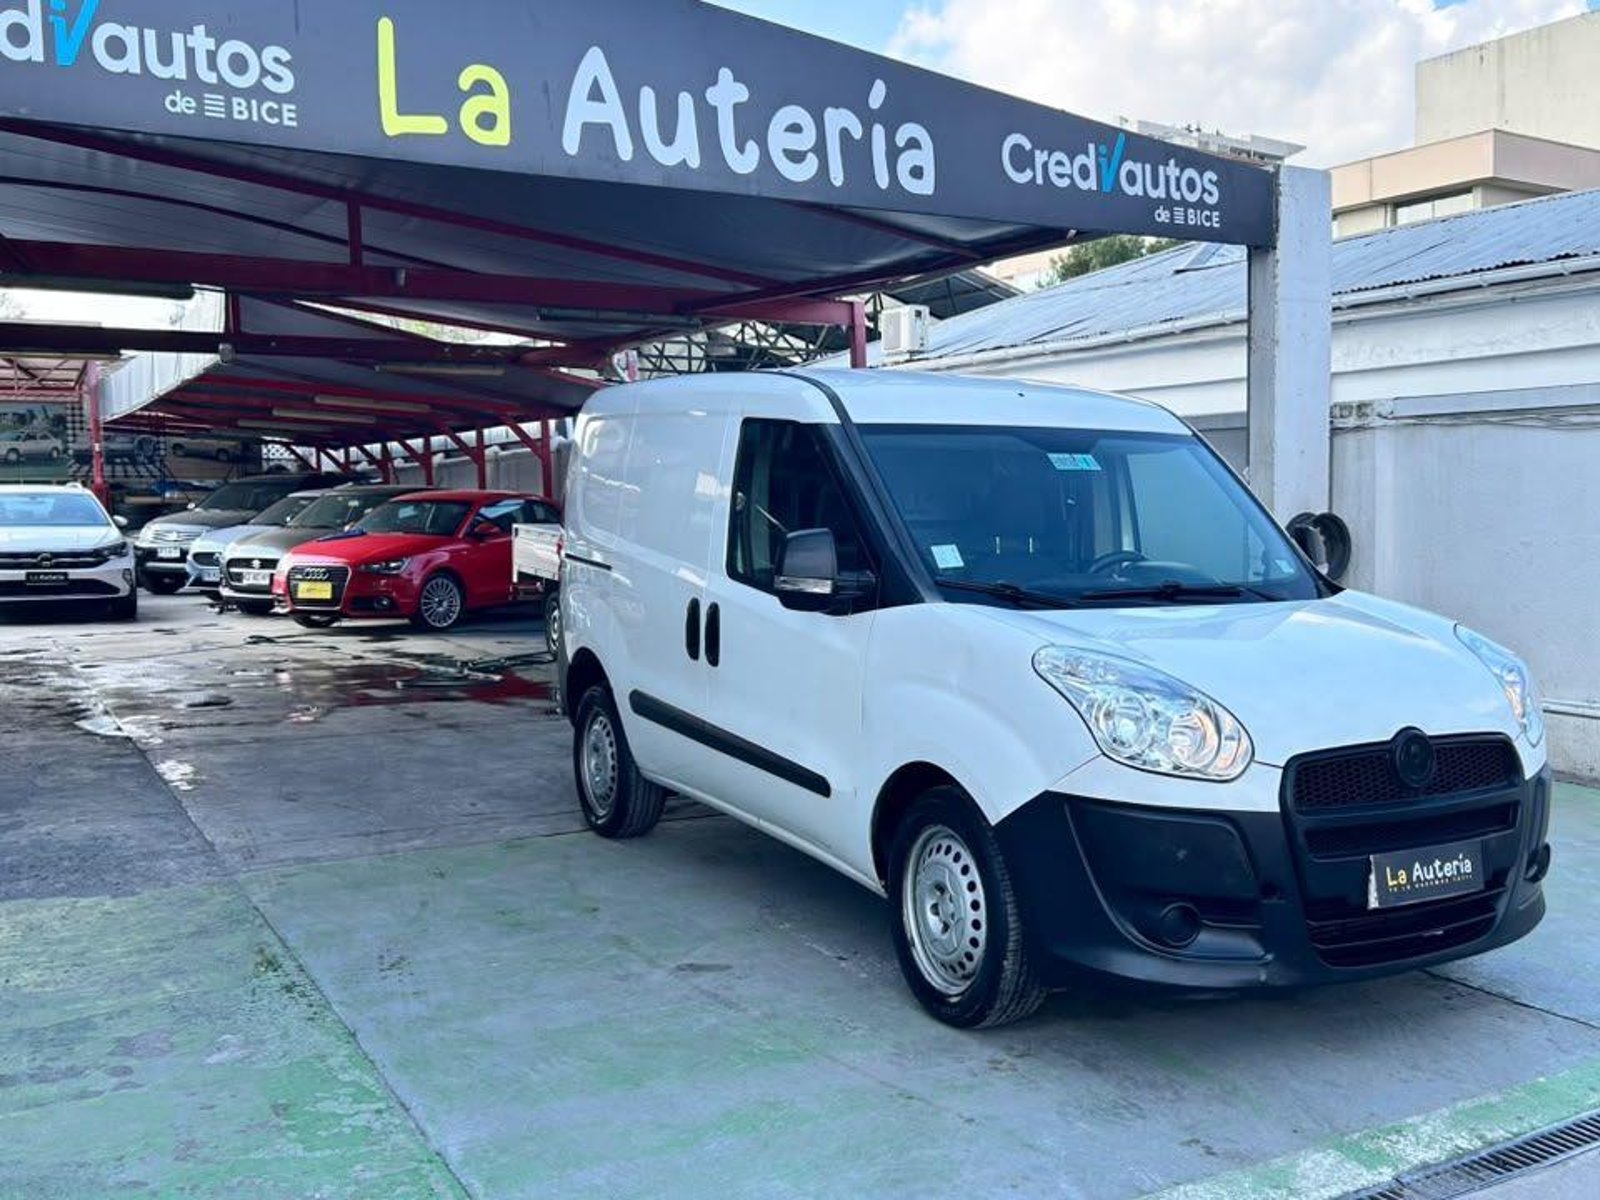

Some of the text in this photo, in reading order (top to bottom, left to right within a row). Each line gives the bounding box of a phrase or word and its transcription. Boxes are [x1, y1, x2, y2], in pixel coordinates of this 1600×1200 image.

[164, 89, 298, 128] de BICE
[377, 16, 936, 196] La Autería
[1154, 205, 1221, 228] de BICE
[1386, 866, 1407, 885] La
[1412, 853, 1472, 882] Autería
